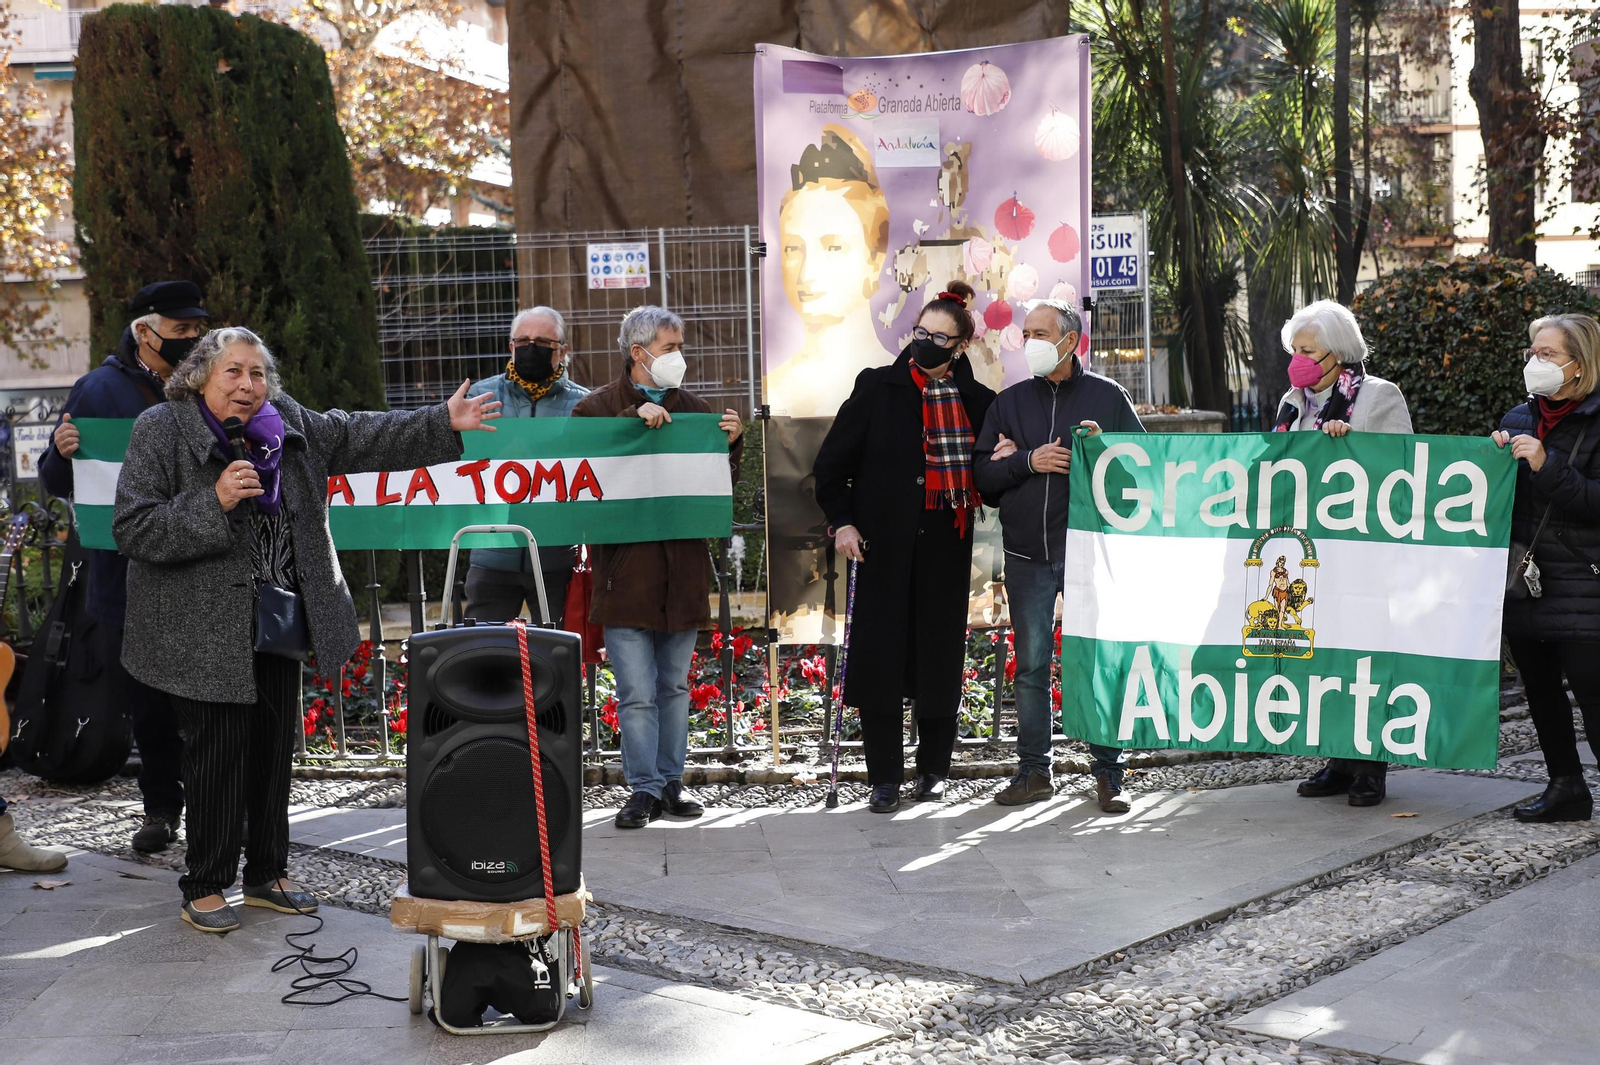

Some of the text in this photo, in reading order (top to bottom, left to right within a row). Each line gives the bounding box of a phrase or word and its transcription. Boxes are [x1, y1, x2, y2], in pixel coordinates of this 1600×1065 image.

[809, 94, 961, 115] Plataforma Granada Abierta
[877, 136, 938, 151] Andalucía
[1096, 256, 1137, 277] 01 45
[1091, 277, 1131, 287] isur.com
[328, 458, 604, 507] A LA TOMA
[1091, 442, 1489, 541] Granada
[1116, 645, 1432, 761] Abierta
[471, 860, 505, 870] ibiza
